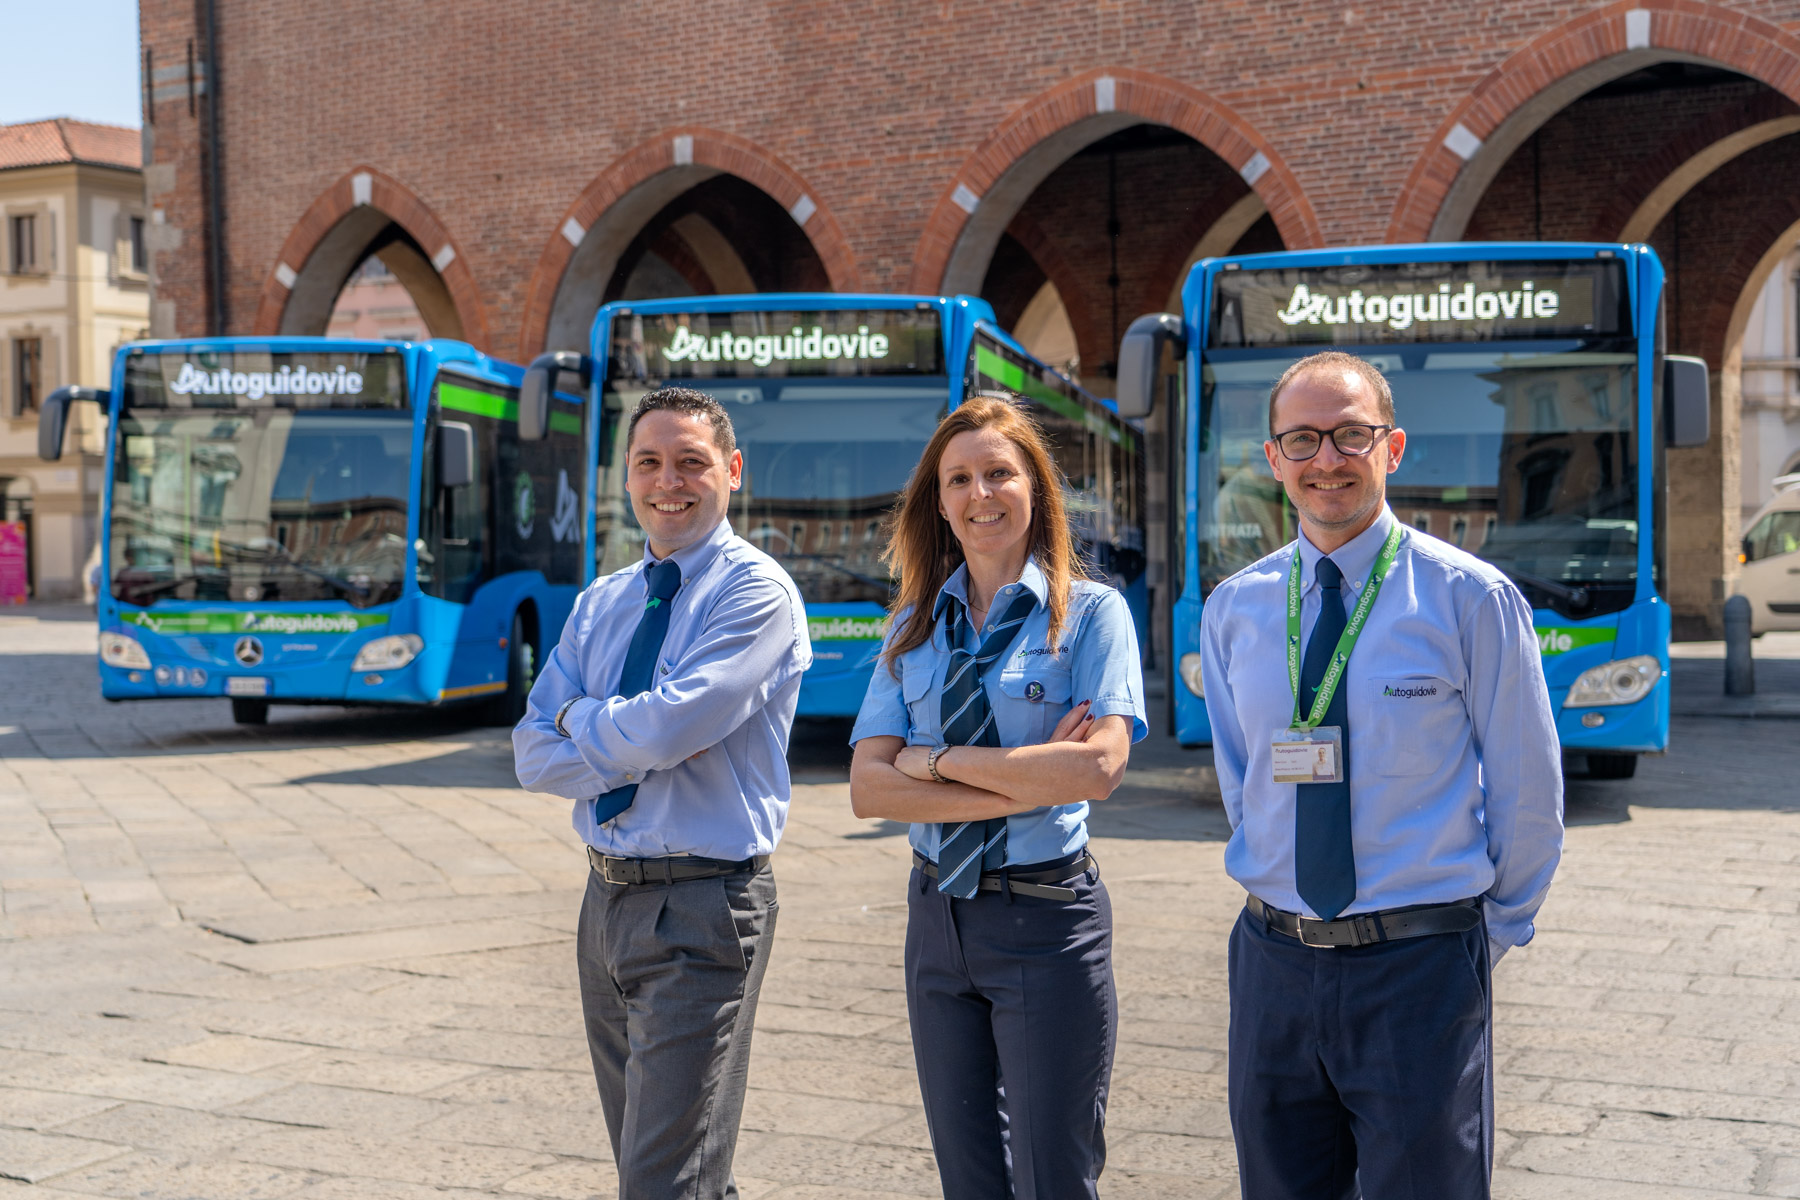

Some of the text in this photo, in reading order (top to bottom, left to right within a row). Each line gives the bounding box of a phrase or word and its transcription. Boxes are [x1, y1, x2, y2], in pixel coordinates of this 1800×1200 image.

[1277, 281, 1559, 330] Autoguidovie
[662, 325, 889, 367] Autoguidovie
[170, 362, 364, 400] Autoguidovie
[242, 612, 359, 634] Autoguidovie
[1347, 572, 1382, 636] Autoguidovie
[809, 618, 884, 641] guidovi
[1018, 644, 1069, 658] Autoguidvie
[1313, 651, 1346, 719] Autoguidovie
[1383, 684, 1437, 699] Autoguidovie
